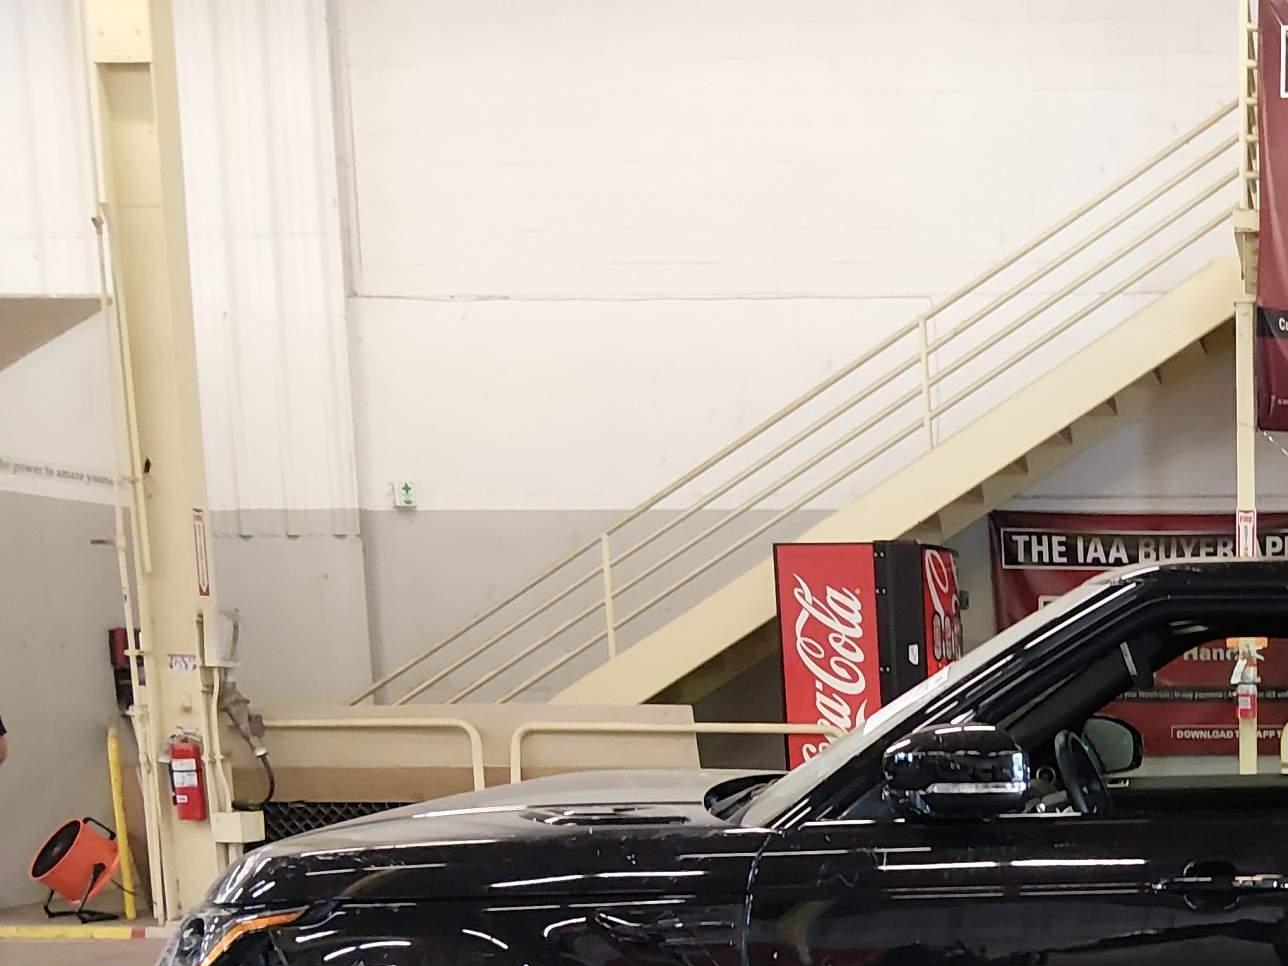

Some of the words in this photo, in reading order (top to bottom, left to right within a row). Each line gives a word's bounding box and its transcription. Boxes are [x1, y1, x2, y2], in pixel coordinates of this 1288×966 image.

[1011, 535, 1068, 563] THE
[1076, 535, 1129, 564] IAA
[1138, 535, 1234, 562] BUYER
[793, 573, 867, 762] a-Cola
[1176, 730, 1234, 739] DOWNLOAD
[1256, 730, 1275, 739] APP
